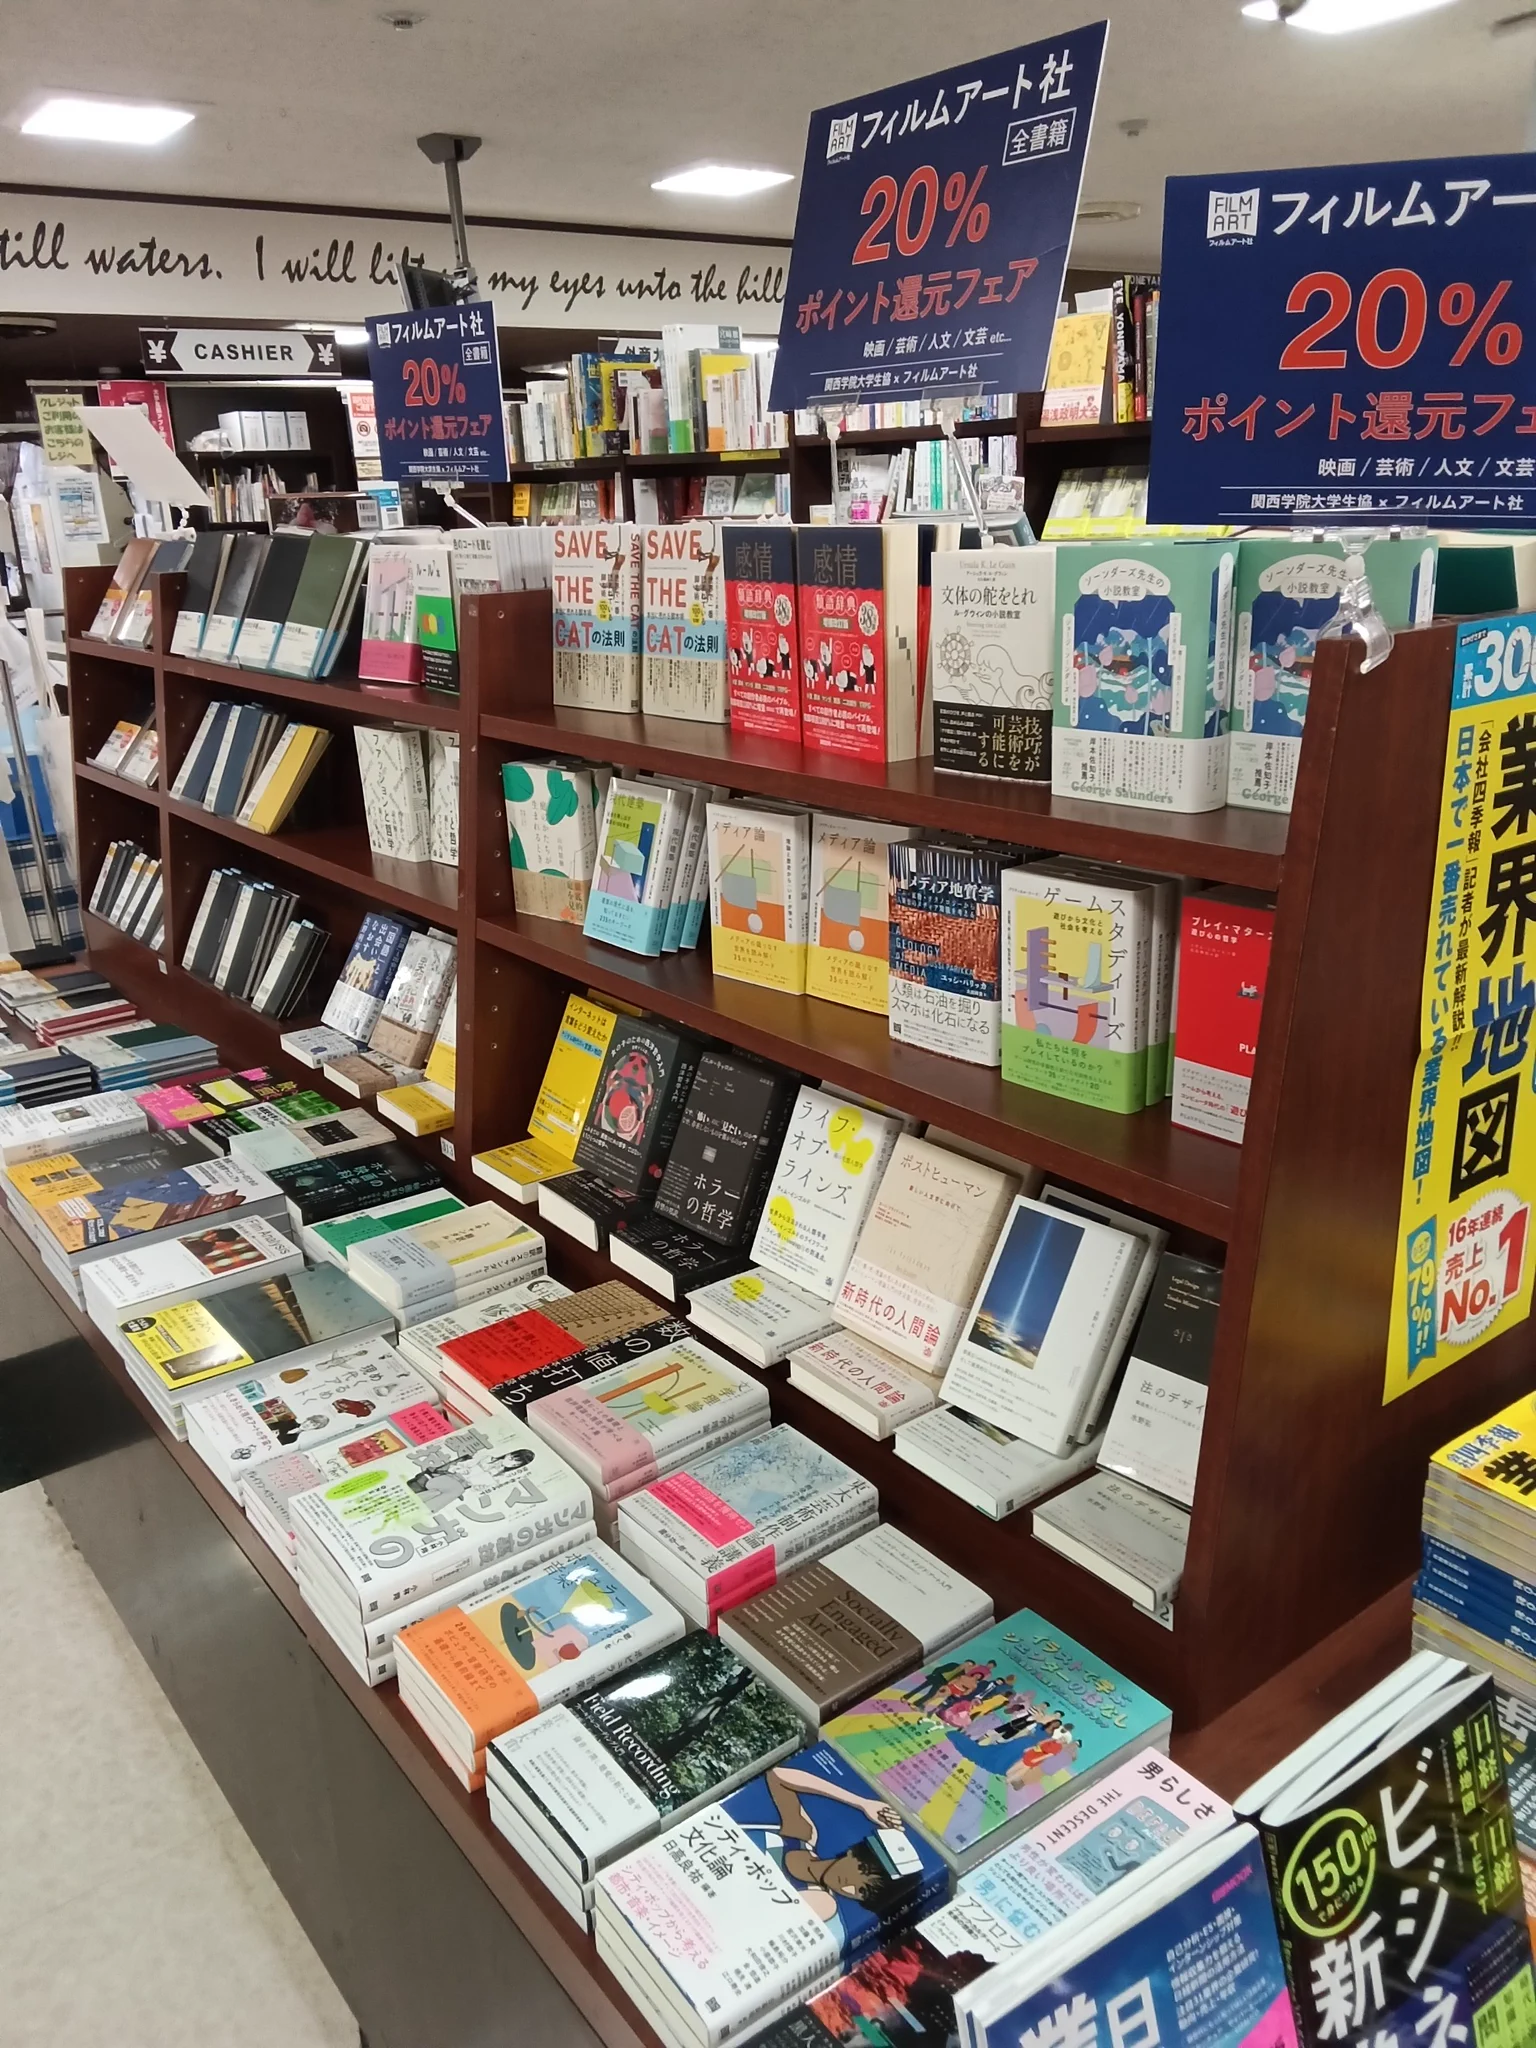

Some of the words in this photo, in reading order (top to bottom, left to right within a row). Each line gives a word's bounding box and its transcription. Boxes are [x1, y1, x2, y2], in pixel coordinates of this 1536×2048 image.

[861, 49, 1074, 149] フィルムアート社
[830, 134, 852, 153] ART
[833, 120, 854, 136] FILM
[1009, 118, 1069, 156] 全書籍
[852, 165, 990, 265] 20%
[1213, 214, 1251, 232] ART
[1215, 195, 1253, 215] FILM
[84, 236, 223, 279] waters.
[255, 235, 265, 280] I
[282, 239, 357, 283] will
[488, 271, 539, 309] my
[549, 270, 606, 312] eyes
[616, 267, 681, 303] unto
[691, 263, 727, 301] the
[796, 258, 1039, 334] ポイント還元フェア
[392, 311, 485, 343] フィルムアート社
[1279, 268, 1523, 370] 20%
[194, 343, 294, 361] CASHIER
[928, 331, 952, 351] 人文
[402, 357, 467, 407] 20%
[903, 363, 978, 384] フィルムアート社
[384, 414, 493, 440] ポイント還元フェア
[1318, 458, 1356, 477] 映画
[1376, 458, 1415, 477] 芸術
[1434, 458, 1474, 477] 人文
[1251, 494, 1372, 511] 関西学院大学生協
[1396, 495, 1524, 512] フィルムアート社
[554, 529, 608, 559] SAVE
[647, 530, 702, 560] SAVE
[735, 541, 773, 580] 感情
[813, 544, 858, 586] 感情
[1085, 568, 1165, 588] ソーンダーズ先生の
[1265, 562, 1352, 583] ソーンダーズ先生
[555, 575, 594, 604] THE
[647, 577, 688, 608] THE
[941, 585, 1037, 606] 文体の舵をとれ
[1103, 584, 1140, 597] 小説教室
[1287, 582, 1330, 595] 小説教室
[1461, 663, 1473, 699] 累計
[977, 731, 990, 767] する
[991, 714, 1006, 769] 可能に
[1008, 715, 1024, 771] 芸術を
[1024, 716, 1043, 772] 技巧が
[711, 820, 766, 843] メディア論
[817, 830, 878, 855] メディア論
[909, 874, 995, 903] メディア地質学
[1053, 912, 1103, 928] 遊びから文化と
[1059, 922, 1103, 936] 社会を考える
[895, 936, 940, 958] GEOLOGY
[895, 960, 927, 979] MEDIA
[570, 1001, 607, 1027] インターネットは
[891, 980, 981, 1017] 人類は石油を掘り
[891, 998, 990, 1036] スマホは化石になる
[564, 1014, 608, 1043] 言葉をどう変えたか
[693, 1174, 741, 1200] ホラー
[782, 1159, 853, 1205] ラインズ
[900, 1153, 989, 1199] ポストヒューマン
[686, 1195, 734, 1230] の哲学
[1449, 1203, 1503, 1244] 16年連続
[248, 1217, 266, 1233] Film
[261, 1229, 291, 1255] Analysis
[652, 1239, 699, 1270] の哲学
[672, 1232, 717, 1262] ホラー
[1445, 1242, 1483, 1285] 売上
[843, 1279, 942, 1348] 新時代の人間論
[291, 1362, 379, 1399] 現代アート
[499, 1321, 688, 1408] 数の値打ち
[808, 1340, 906, 1406] 新時代の人間論
[297, 1370, 386, 1407] めくるめく
[405, 1421, 497, 1480] 裏技
[695, 1477, 874, 1573] 東大「芸術制作論」講義
[1106, 1482, 1185, 1531] 法のデザイン
[799, 1609, 836, 1638] Art
[815, 1596, 896, 1662] Engaged
[835, 1585, 909, 1645] Socially
[996, 1629, 1137, 1730] ジェンダーのはなし
[1026, 1631, 1137, 1710] イラストで学ぶ
[580, 1690, 624, 1727] Field
[604, 1722, 688, 1803] Recording
[1094, 1786, 1125, 1808] THE
[1134, 1759, 1221, 1822] 男らしさ
[1042, 1803, 1100, 1845] DESCENT
[661, 1836, 706, 1887] 日高良祐
[678, 1822, 736, 1883] 文化論
[701, 1807, 800, 1919] シティ・ポップ
[1468, 1833, 1487, 1915] TEST
[619, 1859, 711, 1976] シティ・ポップから考える
